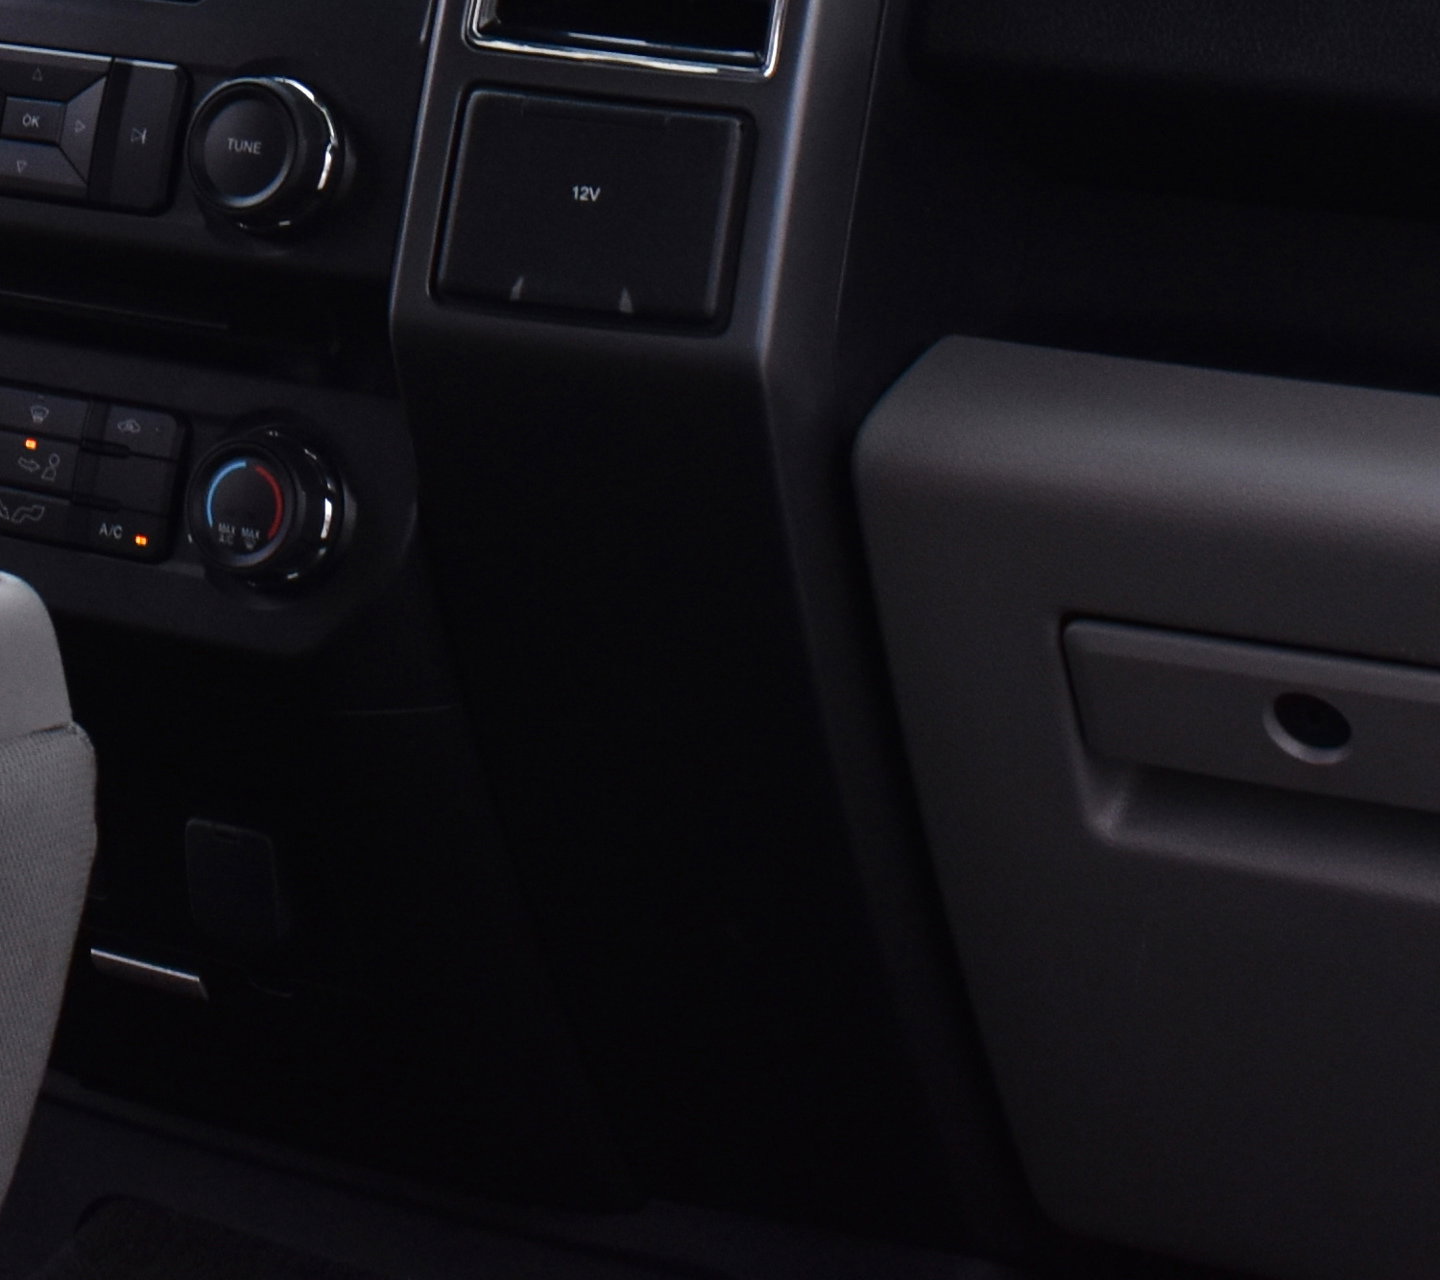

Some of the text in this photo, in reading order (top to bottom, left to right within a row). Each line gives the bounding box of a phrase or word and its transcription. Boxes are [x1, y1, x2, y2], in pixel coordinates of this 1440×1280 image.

[22, 113, 40, 128] OK
[227, 137, 262, 156] TUNE
[572, 185, 601, 202] 12V
[99, 522, 124, 540] A/C
